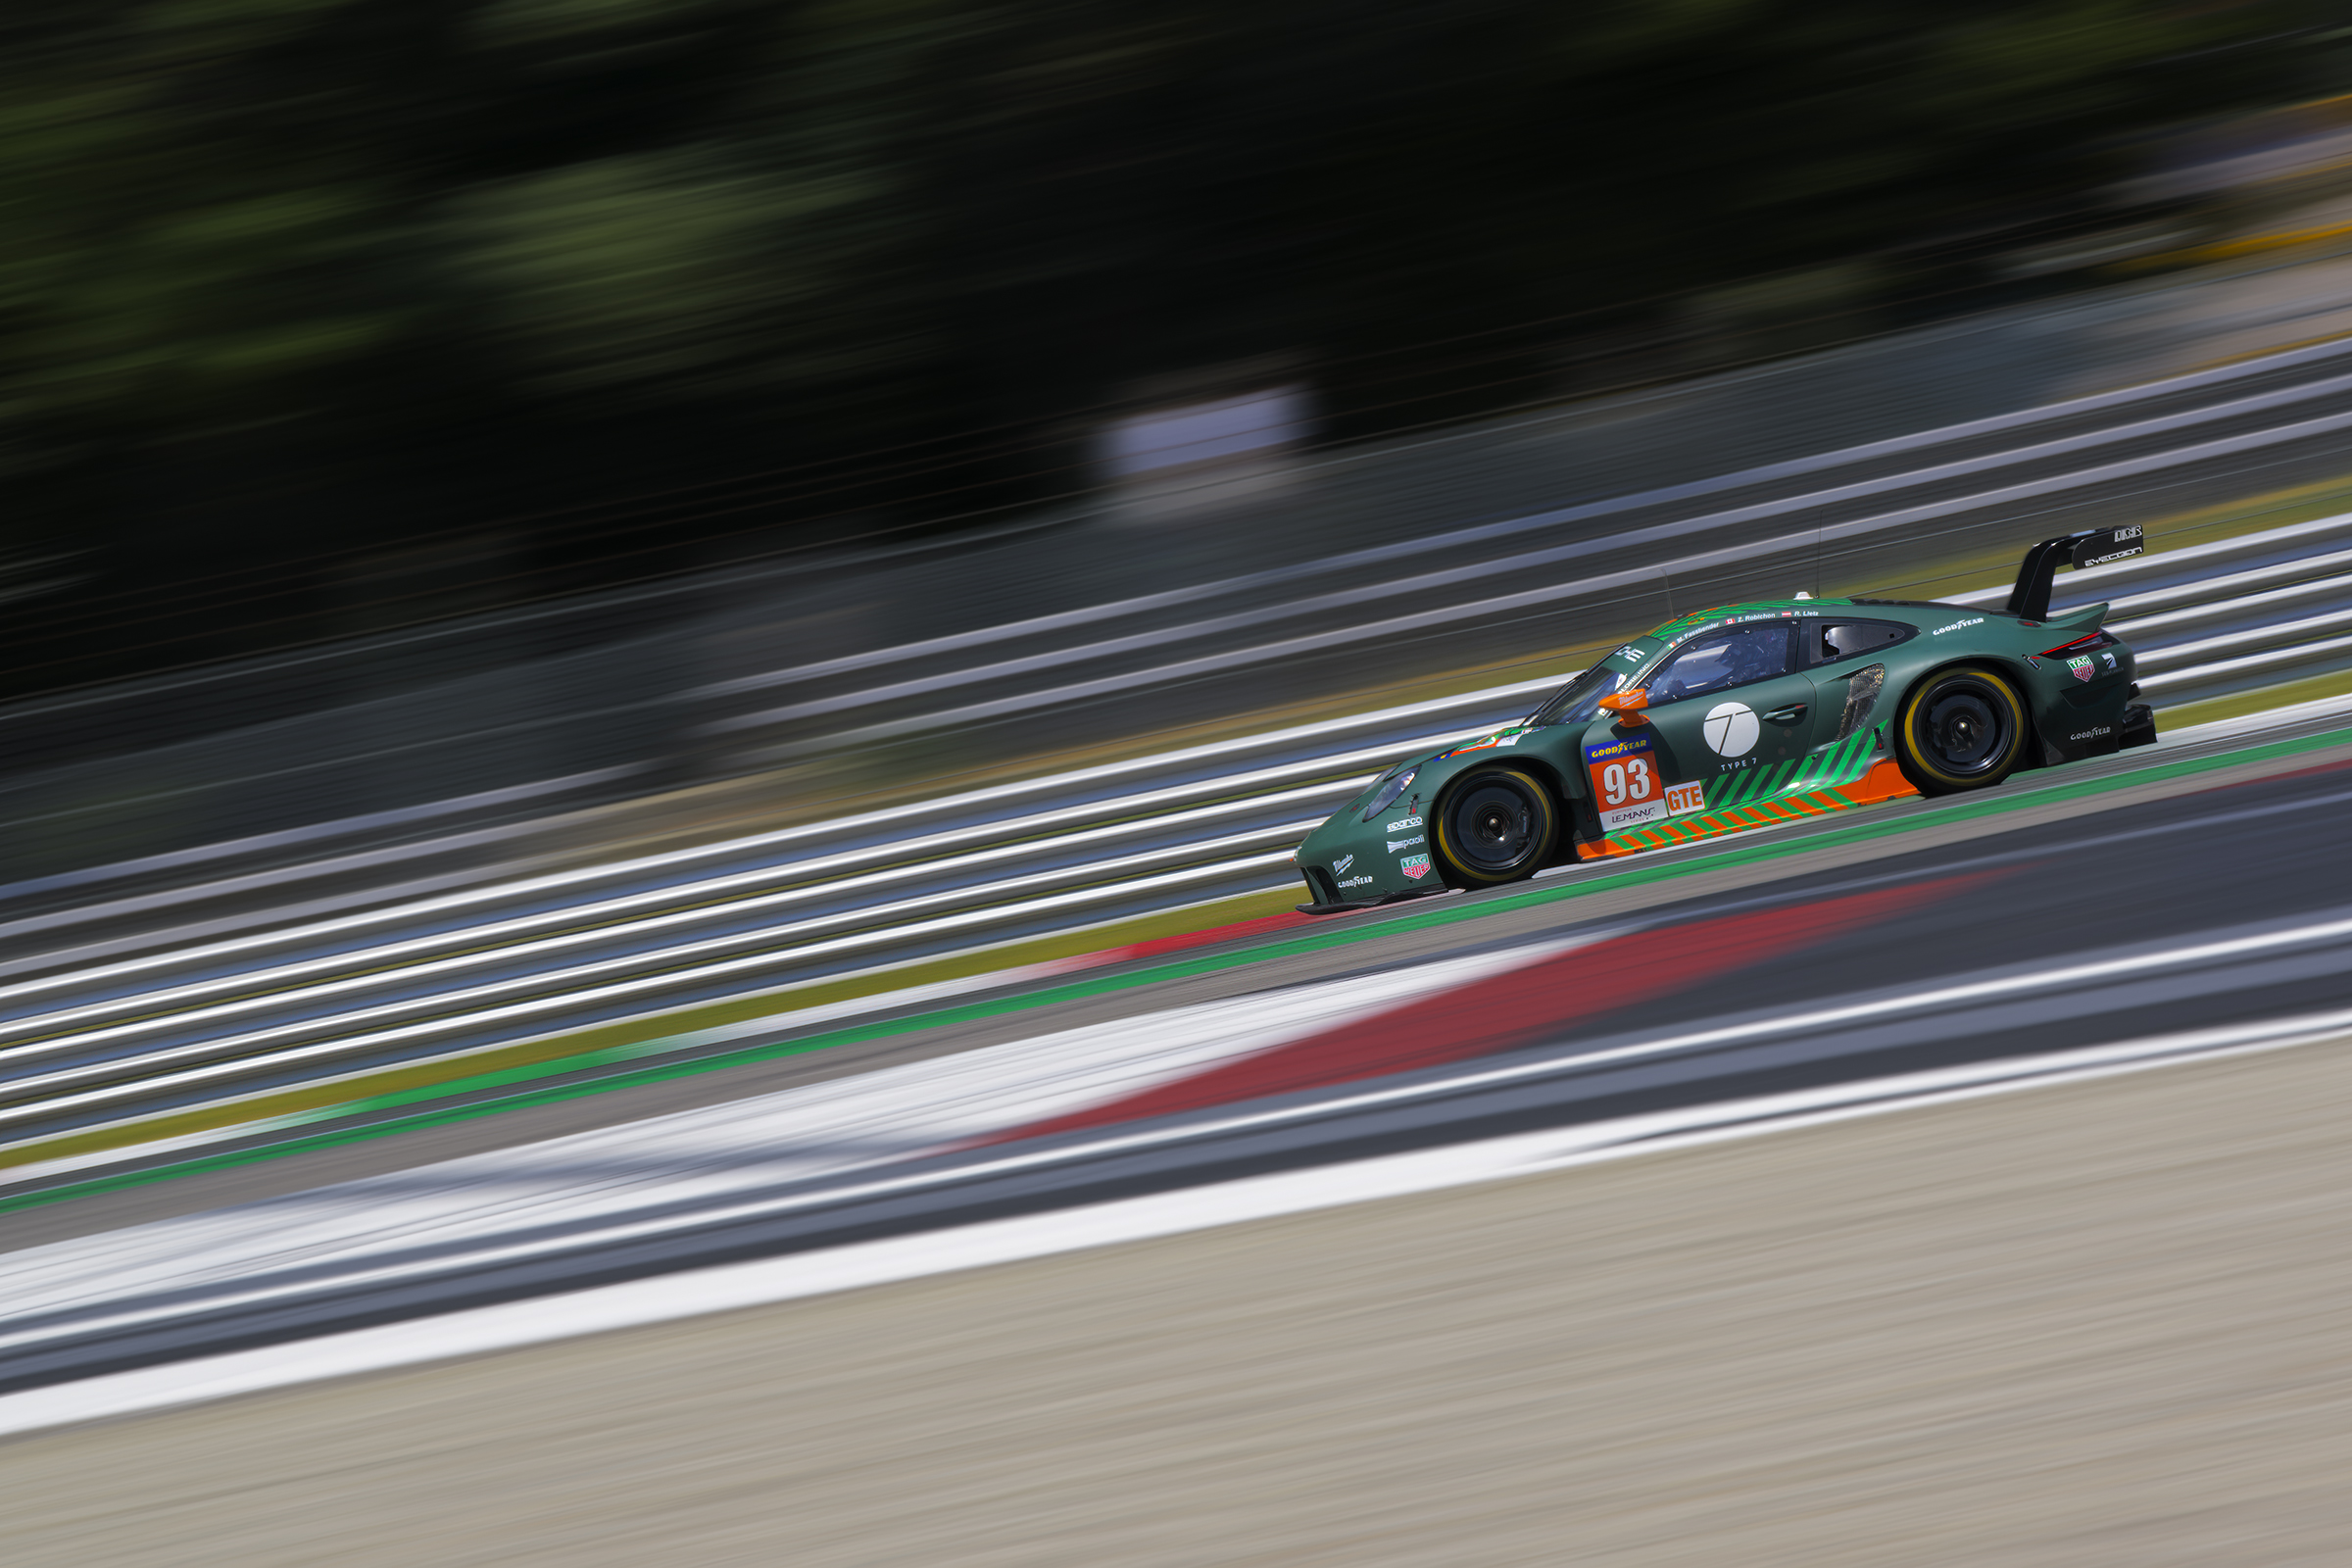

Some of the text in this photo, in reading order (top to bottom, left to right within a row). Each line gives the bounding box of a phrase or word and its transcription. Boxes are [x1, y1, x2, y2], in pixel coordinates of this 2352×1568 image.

[1933, 617, 1984, 636] GOODYEAR
[2070, 657, 2090, 668] TAG
[2070, 726, 2111, 741] GOODYEAR
[1592, 739, 1647, 759] GOODYEAR
[1721, 760, 1747, 771] TYPE
[1603, 758, 1651, 806] 93
[1667, 785, 1703, 811] GTE
[1387, 816, 1423, 832] sparco
[1403, 856, 1427, 866] TAG
[1338, 875, 1373, 888] GOODYEAR
